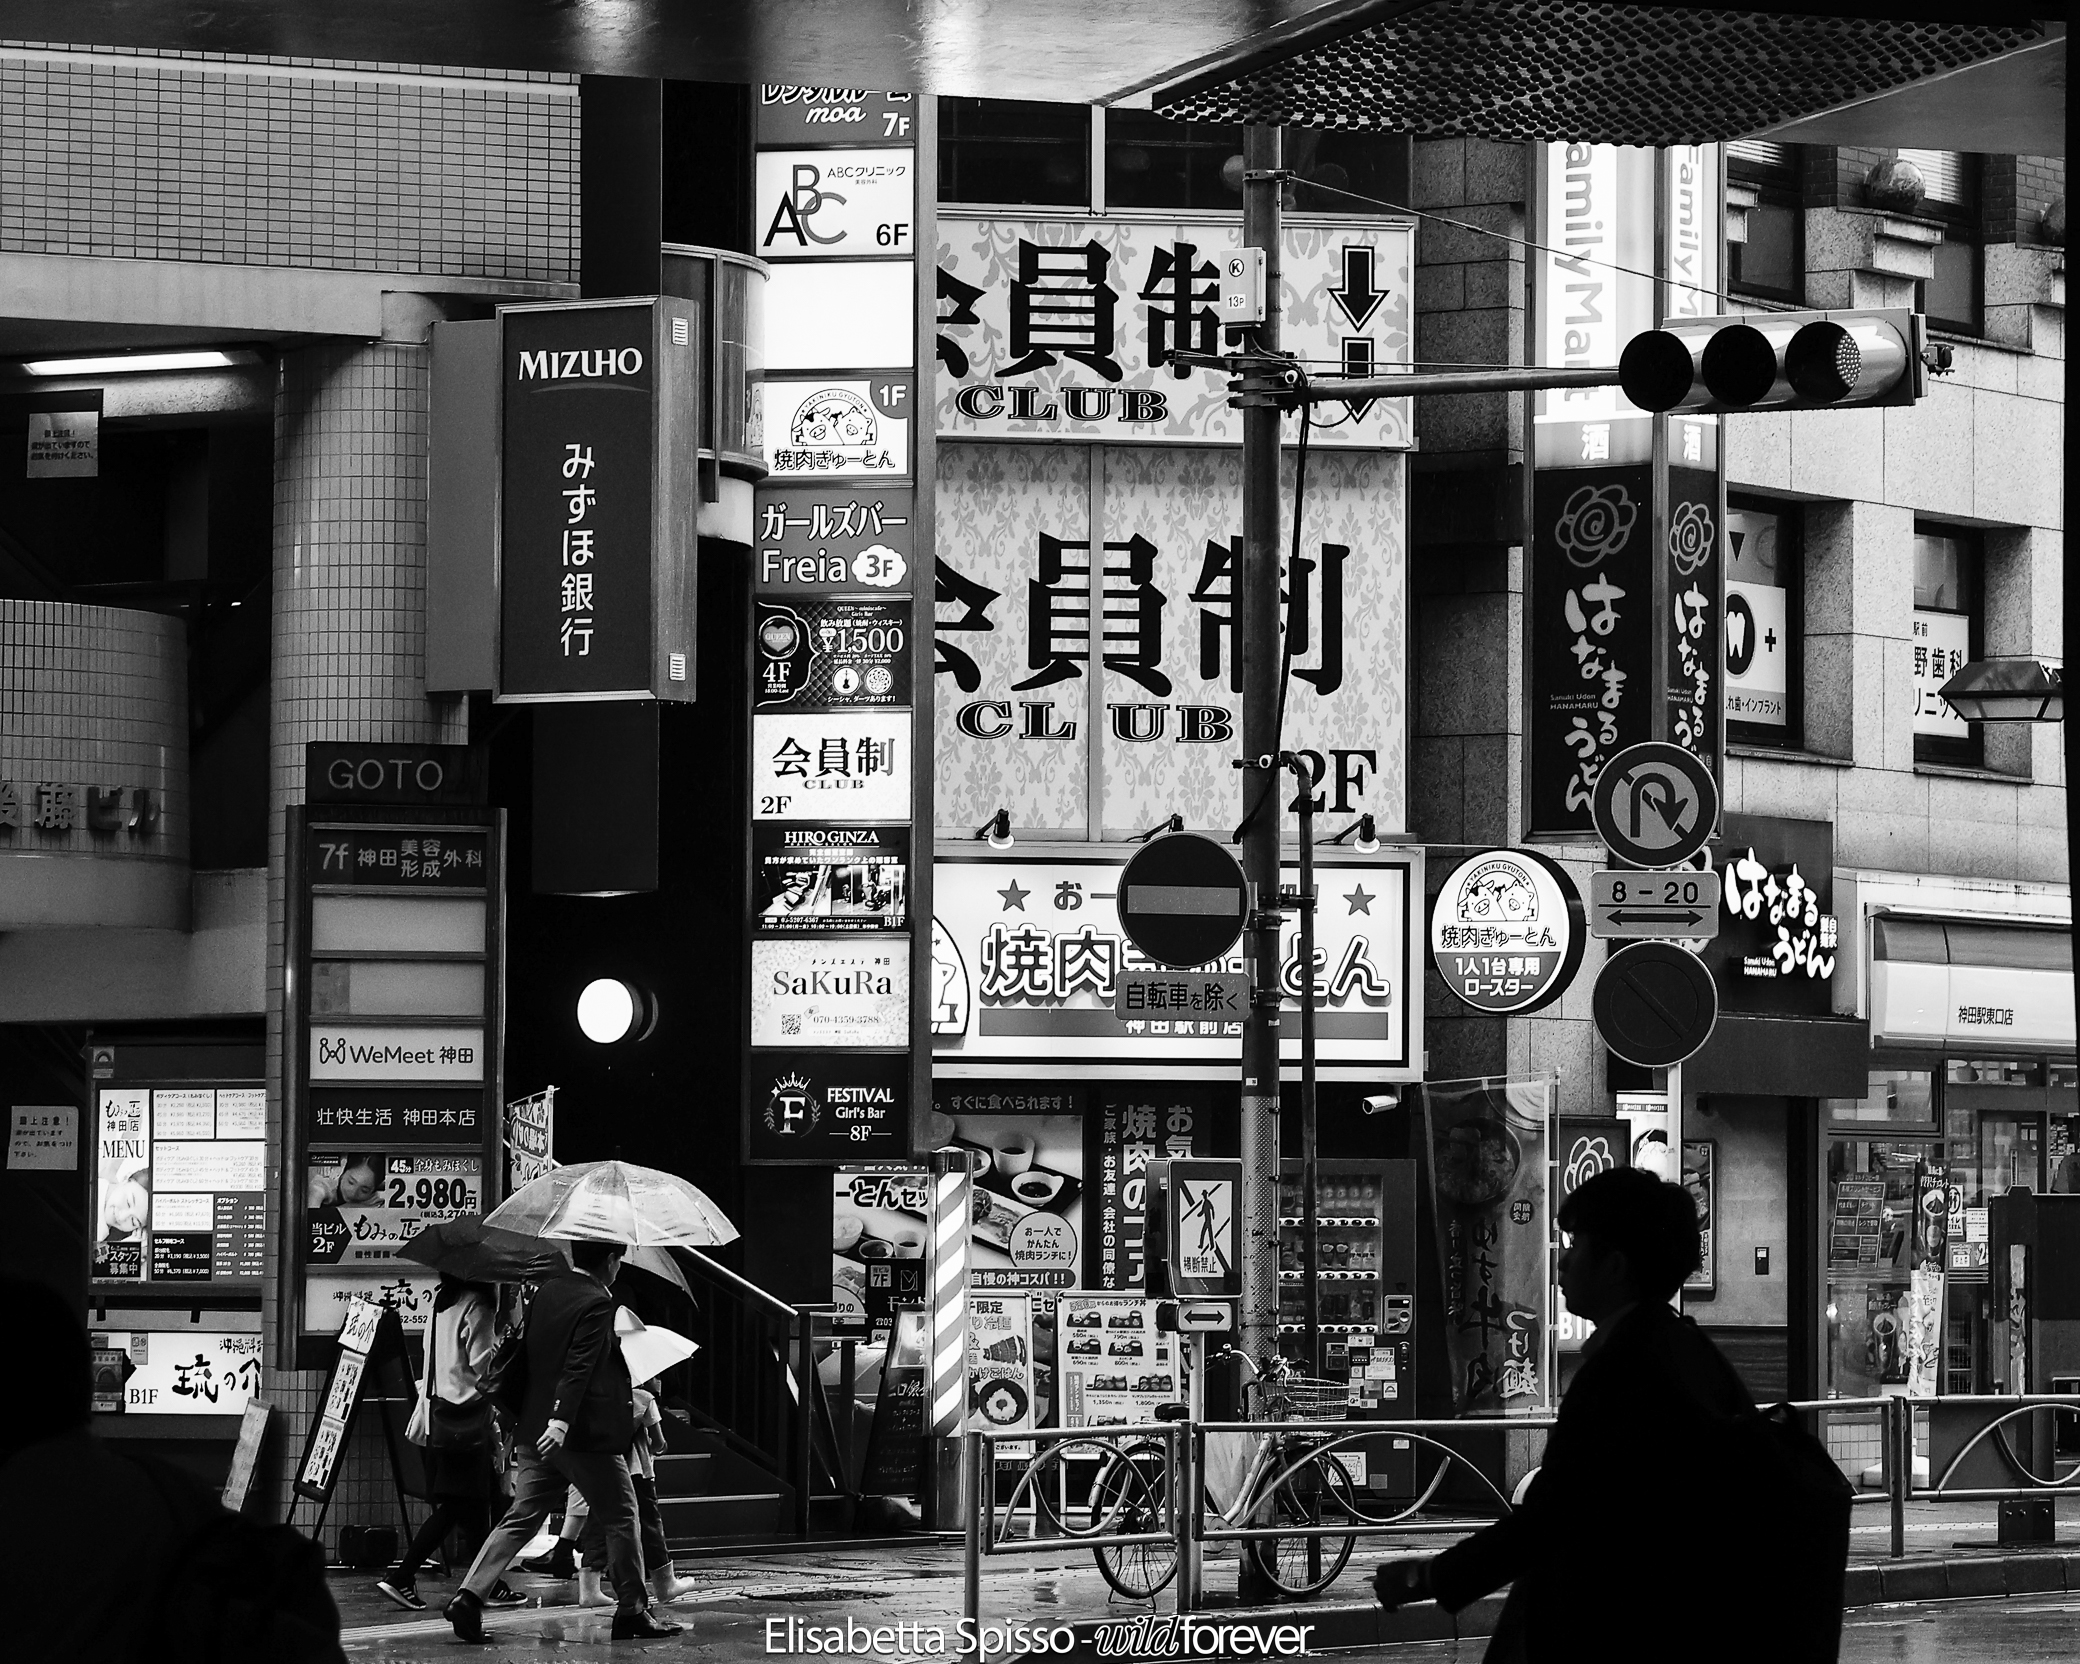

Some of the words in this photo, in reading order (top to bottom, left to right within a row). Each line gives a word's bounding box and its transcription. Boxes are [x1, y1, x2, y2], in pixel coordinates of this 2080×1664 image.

[805, 105, 866, 124] moa
[882, 112, 910, 137] 7F
[827, 166, 906, 178] ABCクリニック
[876, 223, 909, 246] 6F
[518, 347, 643, 381] MIZUHO
[804, 391, 838, 409] YAKINIKU
[838, 391, 864, 408] GYUTON
[879, 384, 907, 407] 1F
[956, 385, 1169, 423] CLUB
[1581, 423, 1610, 461] 酒
[1683, 423, 1702, 462] 酒
[774, 448, 895, 470] 焼肉ぎゅーとん
[760, 501, 907, 542] ガールズバー
[561, 443, 597, 657] みずほ銀行
[762, 548, 848, 583] Freia
[865, 554, 893, 577] 3F
[762, 662, 792, 683] 4F
[1550, 702, 1599, 710] HANAMARU
[1726, 695, 1781, 716] れ歯・インプラント
[772, 736, 896, 778] 会員制
[327, 759, 444, 791] GOTO
[802, 779, 865, 790] CLUB
[760, 796, 792, 814] 2F
[784, 831, 826, 846] HIRO
[827, 831, 880, 843] GINZA
[319, 843, 349, 870] 7f
[1469, 863, 1501, 884] YAKINIKU
[1502, 863, 1529, 884] GYUTON
[883, 916, 906, 927] B1F
[1440, 925, 1557, 948] 焼肉ぎゅーとん
[1772, 925, 1836, 980] うどん
[1455, 956, 1541, 977] 1人1台専用
[773, 970, 893, 996] SaKuRa
[1464, 978, 1534, 997] ロースター
[1125, 980, 1238, 1012] 自転車を除く
[1958, 1005, 2014, 1026] 神田駅東口店
[349, 1045, 435, 1065] WeMeet
[439, 1046, 474, 1065] 神田
[827, 1087, 895, 1103] FESTIVAL
[316, 1107, 393, 1126] 壮快生活
[402, 1108, 476, 1127] 神田本店
[835, 1106, 865, 1119] Girl's
[867, 1106, 886, 1119] Bar
[106, 1120, 140, 1132] 神田店
[850, 1125, 872, 1141] 8F
[102, 1139, 145, 1159] MENU
[311, 1222, 347, 1235] 当ビル
[1024, 1227, 1062, 1237] お一人で
[312, 1236, 335, 1253] 2F
[1026, 1239, 1060, 1249] かんたん
[1014, 1249, 1072, 1261] 焼肉ランチに！
[873, 1273, 889, 1287] 7F
[129, 1388, 159, 1405] B1F
